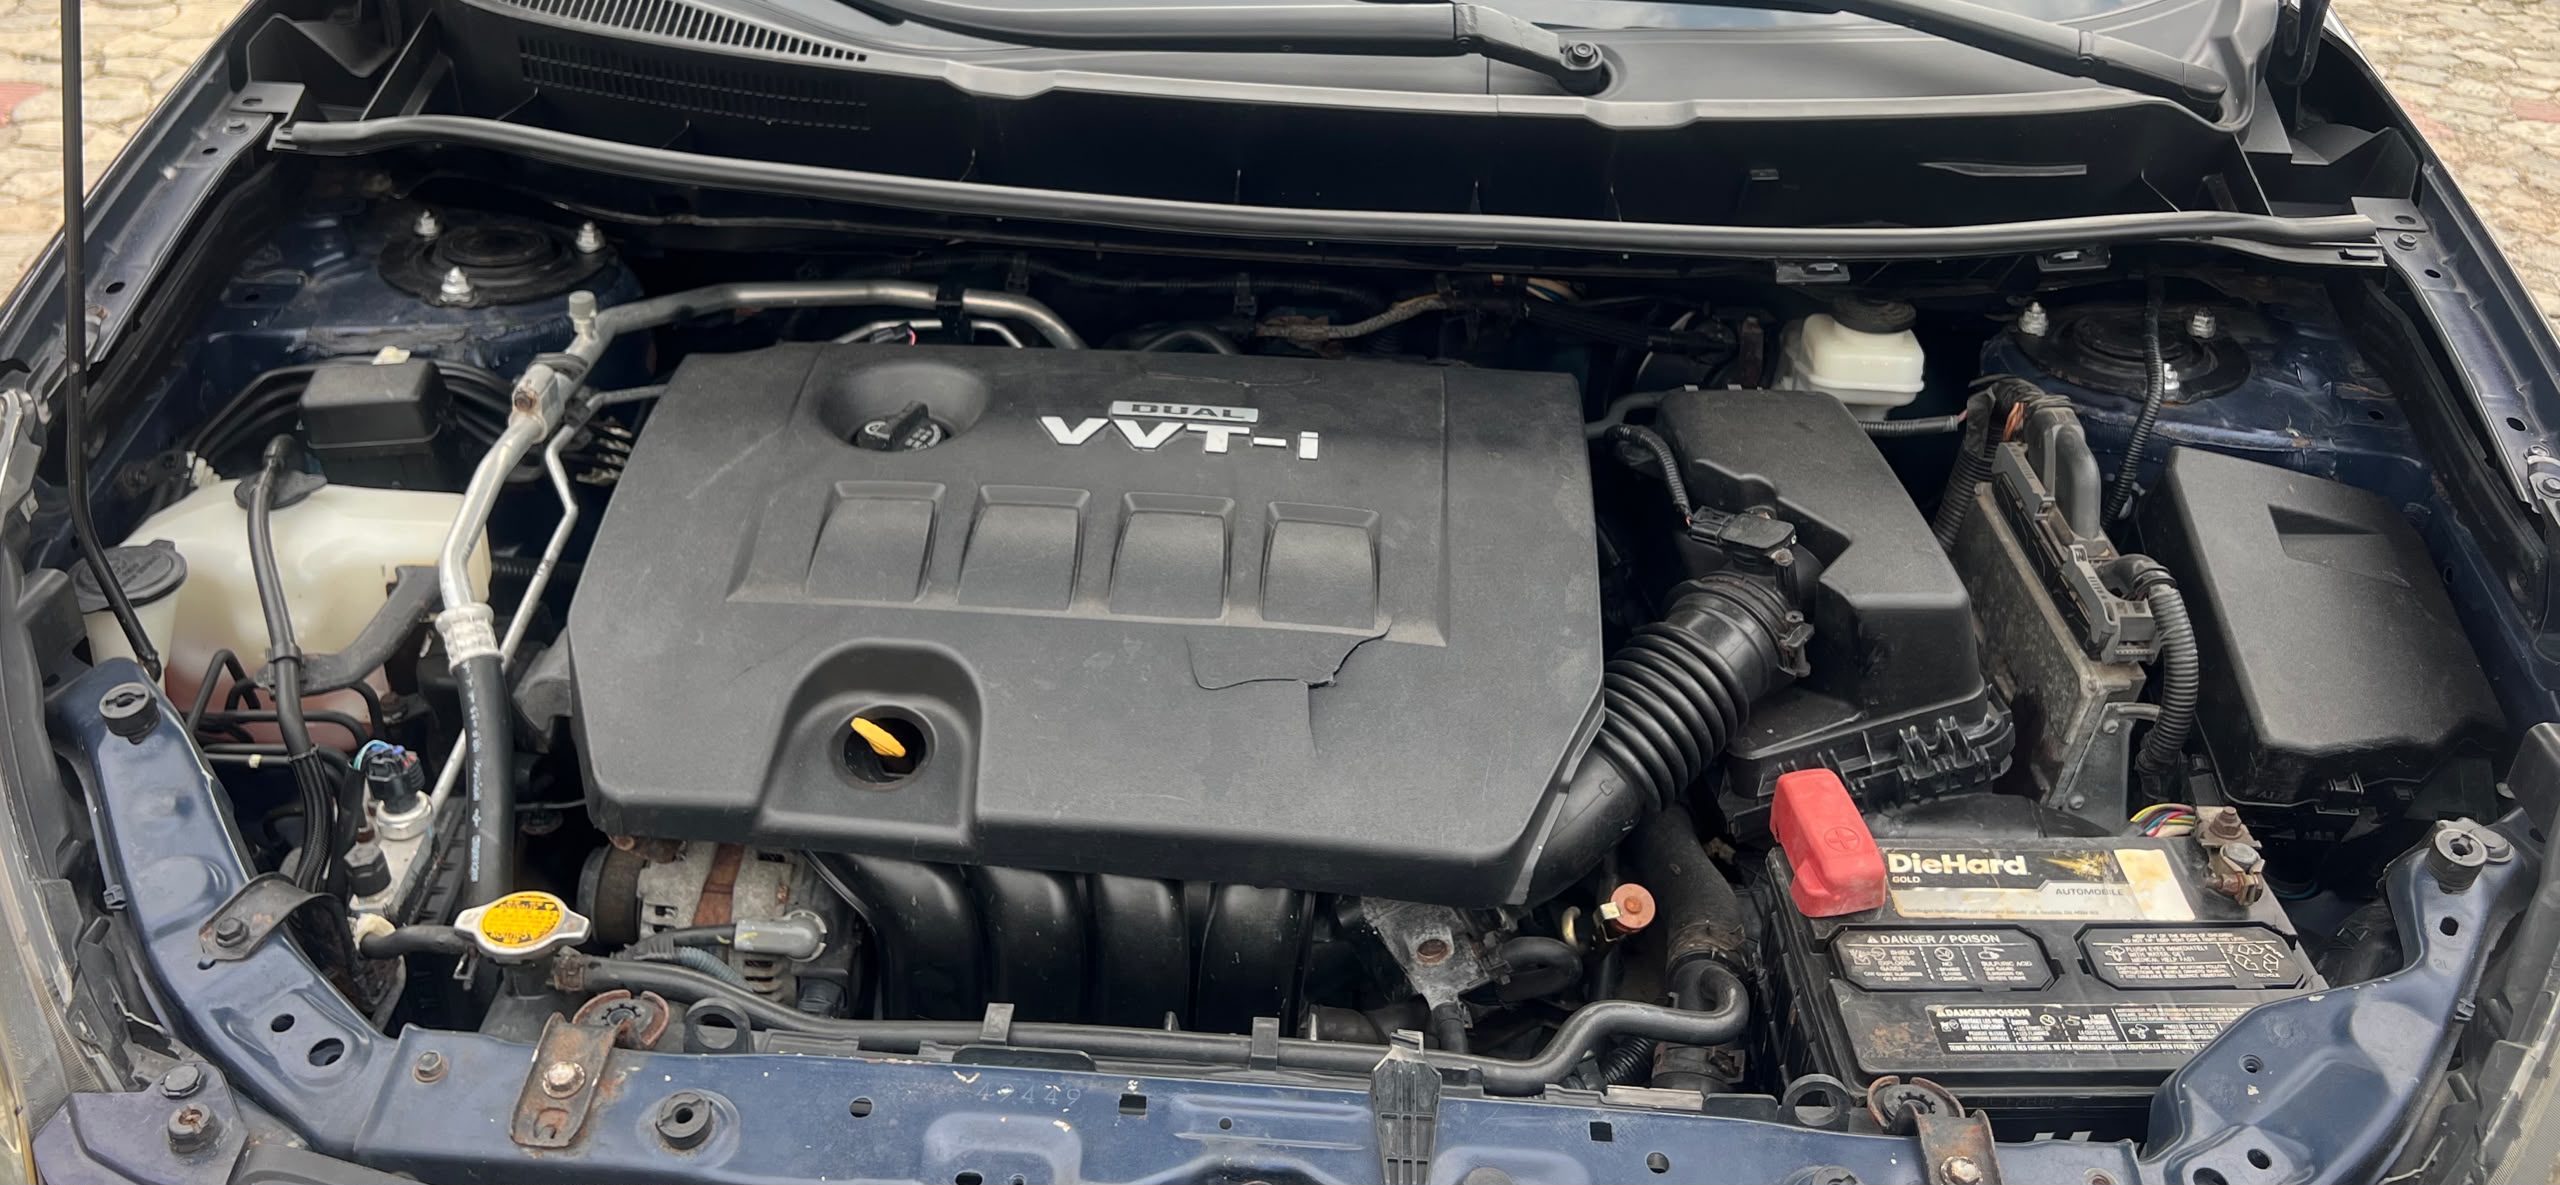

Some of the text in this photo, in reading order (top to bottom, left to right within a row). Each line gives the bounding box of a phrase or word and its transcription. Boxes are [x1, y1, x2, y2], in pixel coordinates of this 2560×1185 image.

[1131, 403, 1246, 419] DUAL
[1040, 415, 1319, 460] VVT-i
[1887, 852, 2028, 876] DieHard
[1892, 876, 1921, 884] GOLD
[2055, 887, 2124, 896] AUTOMOBILE
[1881, 934, 2000, 944] DANGER / POISON
[1945, 1008, 2032, 1017] DANGER/POISON
